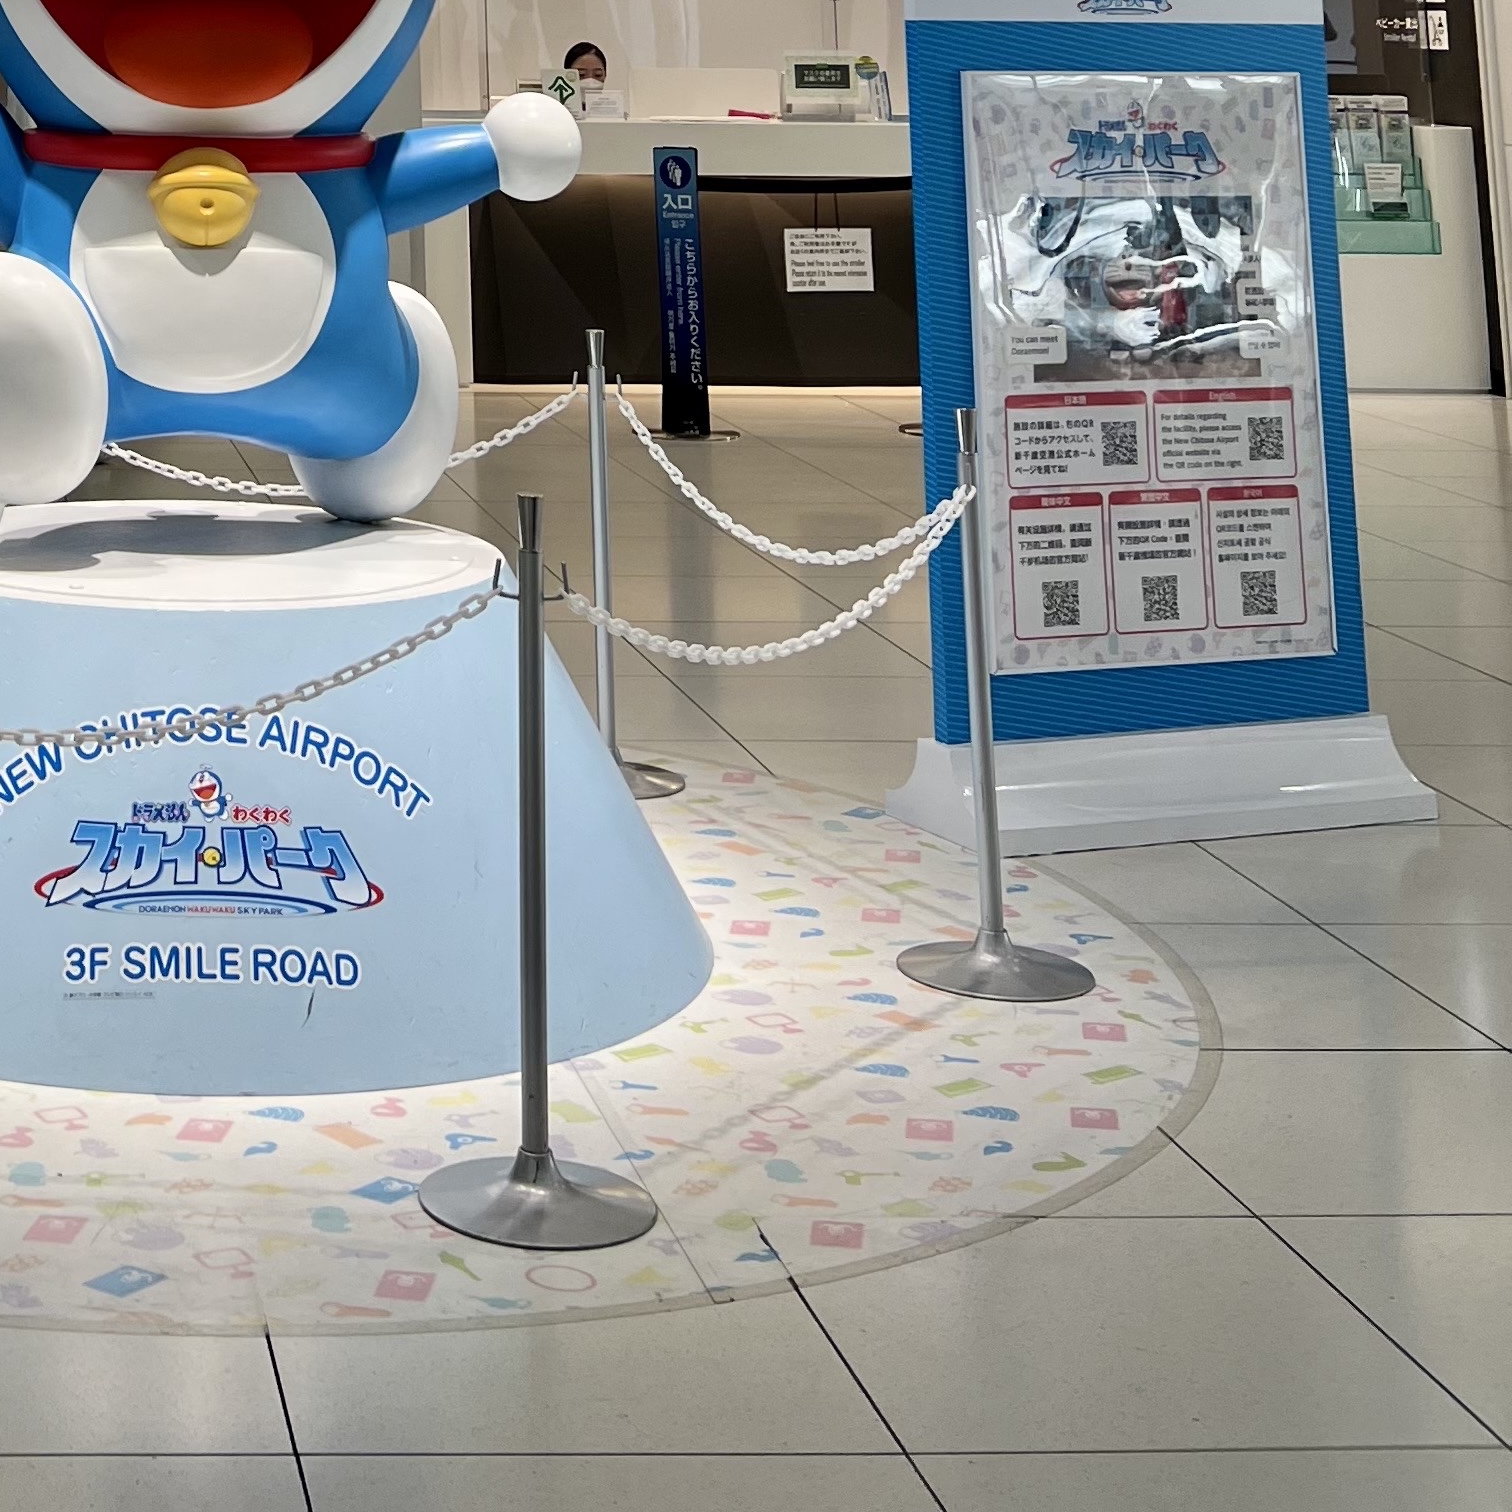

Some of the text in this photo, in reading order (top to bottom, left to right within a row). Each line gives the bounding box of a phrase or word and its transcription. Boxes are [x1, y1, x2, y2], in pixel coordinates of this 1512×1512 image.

[662, 194, 692, 210] 入口
[663, 211, 695, 220] Entrance
[670, 219, 686, 229] 입구
[684, 238, 703, 390] こちらからお入りください。
[1039, 335, 1059, 344] meet
[1064, 395, 1087, 406] 日本語
[1208, 391, 1237, 402] English
[1216, 435, 1239, 444] Airport
[259, 715, 431, 817] AIRPORT
[131, 802, 190, 823] ドラえもん
[233, 806, 292, 823] わくわく
[138, 905, 284, 915] DORAEMON WAKUWAKU SKY PARK
[65, 945, 359, 986] 3F SMILE ROAD
